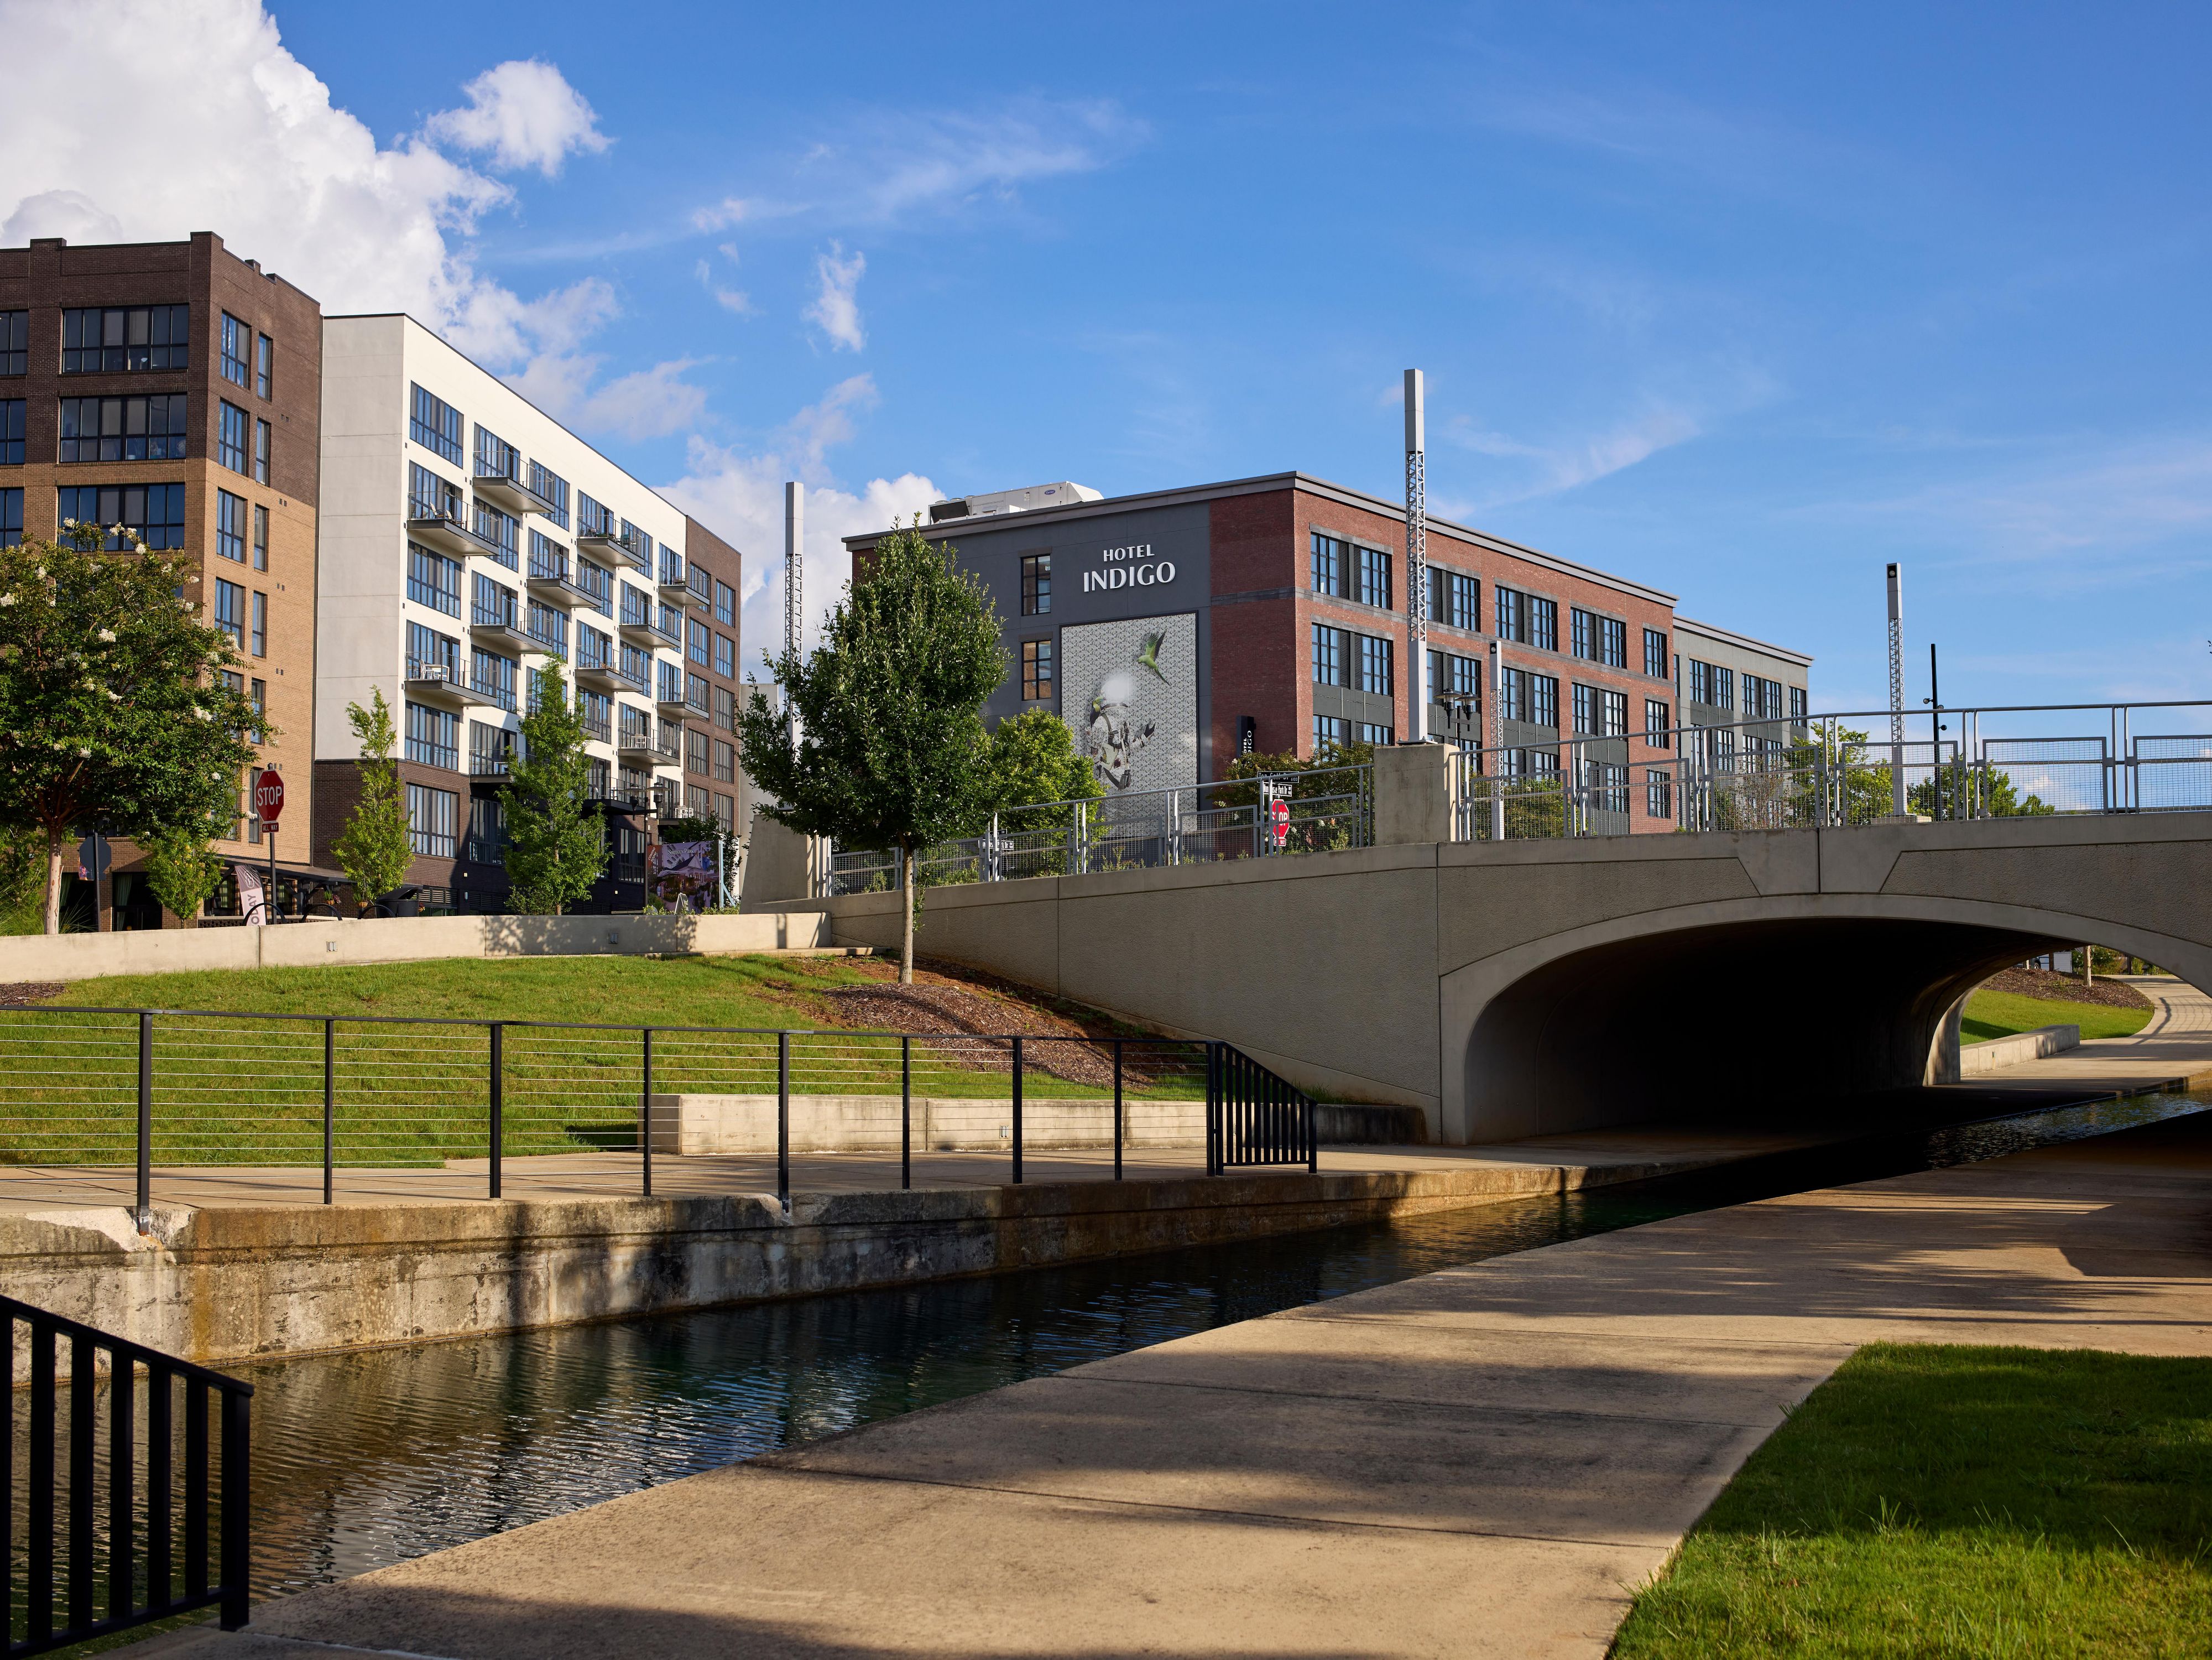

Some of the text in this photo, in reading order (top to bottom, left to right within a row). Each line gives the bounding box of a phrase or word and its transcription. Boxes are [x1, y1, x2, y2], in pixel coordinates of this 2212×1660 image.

[1103, 544, 1155, 562] HOTEL
[1083, 561, 1176, 592] INDIGO
[257, 785, 283, 806] STOP
[1272, 811, 1288, 826] SOP
[247, 894, 260, 925] ODAY
